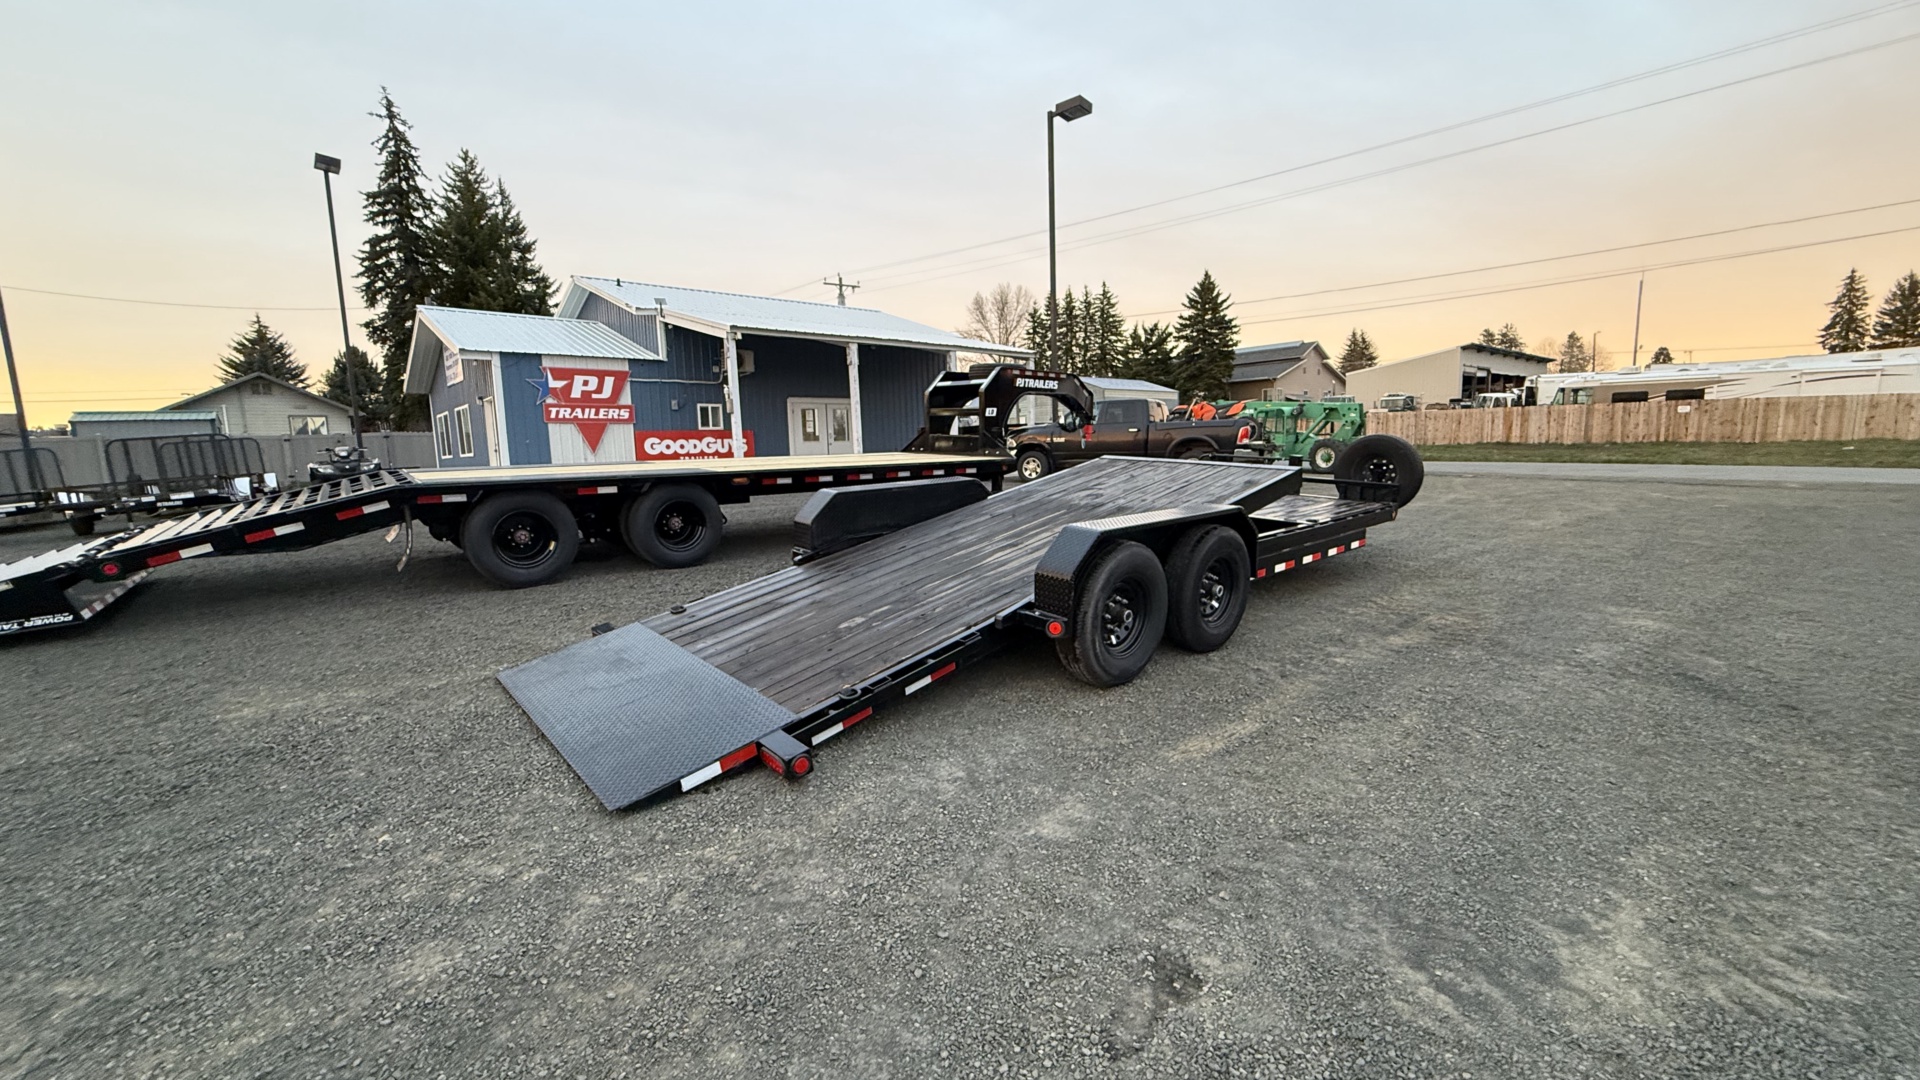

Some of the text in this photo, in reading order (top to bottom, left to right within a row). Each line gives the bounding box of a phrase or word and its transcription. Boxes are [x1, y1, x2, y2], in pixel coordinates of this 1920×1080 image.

[570, 375, 615, 399] PJ
[1025, 378, 1059, 390] TRAILERS
[548, 407, 630, 419] TRAILERS
[23, 614, 74, 627] POWER
